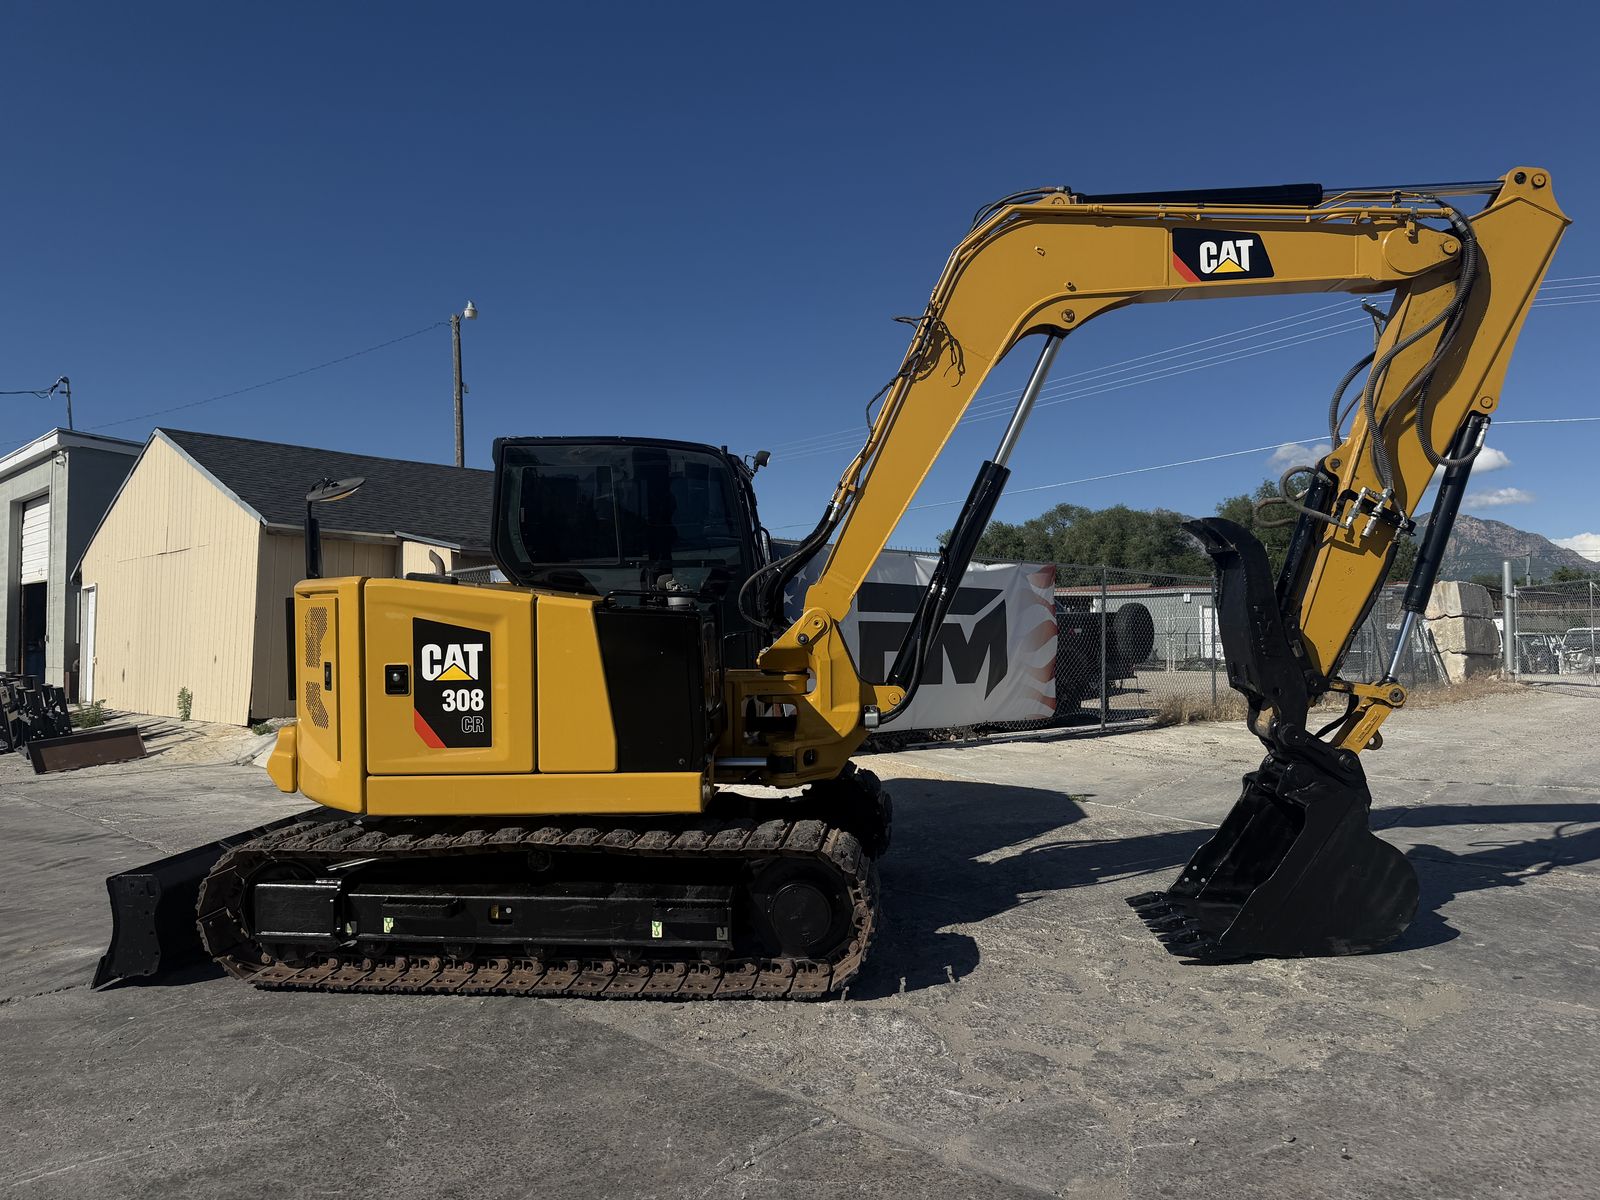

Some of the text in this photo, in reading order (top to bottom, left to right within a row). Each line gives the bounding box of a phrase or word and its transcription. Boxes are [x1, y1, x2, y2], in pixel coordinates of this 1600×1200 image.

[1199, 239, 1254, 274] CAT
[421, 643, 484, 681] CAT
[442, 689, 484, 712] 308
[461, 716, 485, 733] CR
